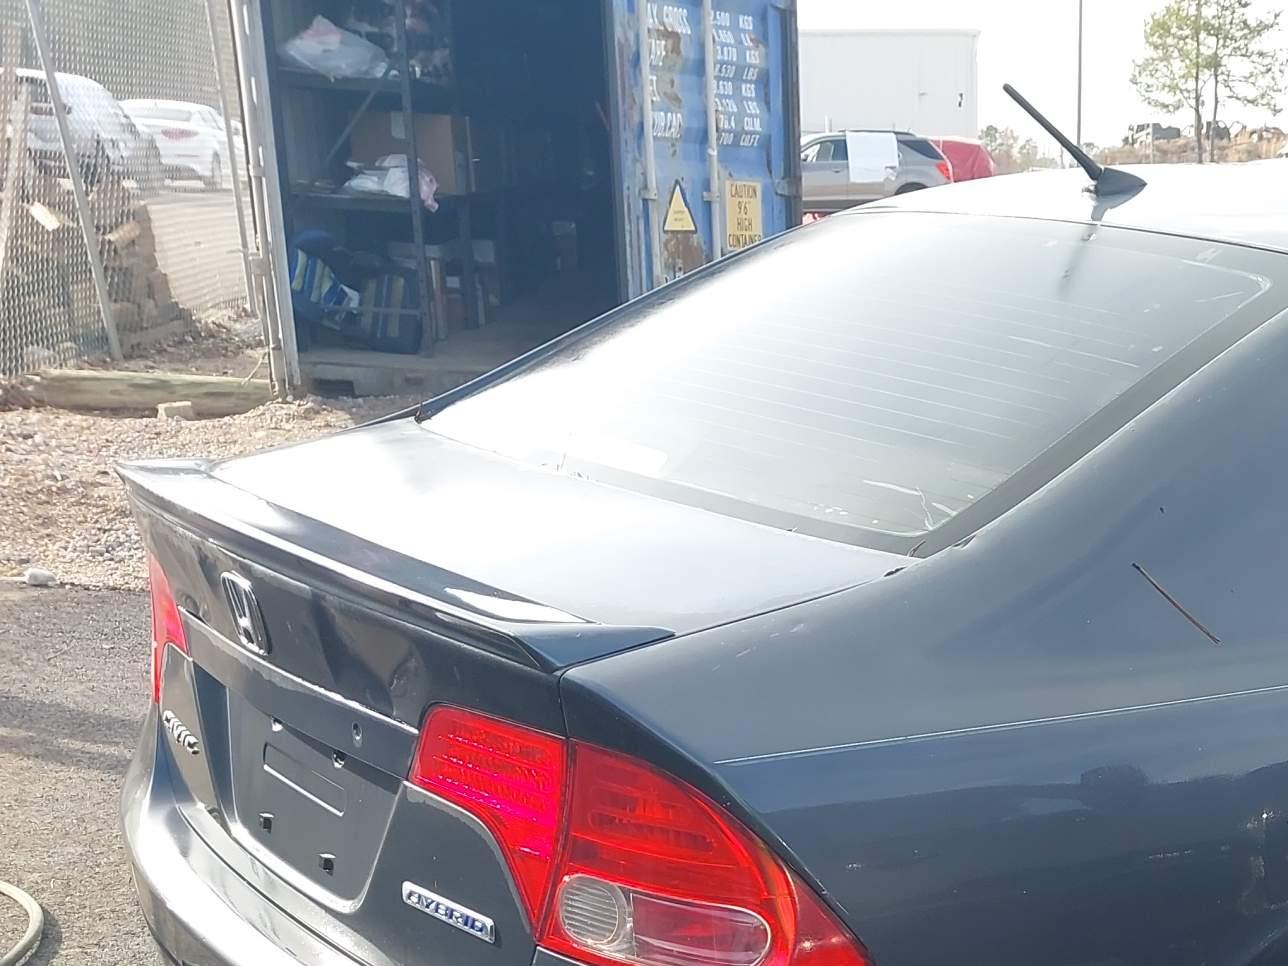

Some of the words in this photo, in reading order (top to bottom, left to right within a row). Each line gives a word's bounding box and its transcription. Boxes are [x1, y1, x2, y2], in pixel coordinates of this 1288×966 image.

[730, 183, 757, 199] CAUTION
[736, 217, 753, 232] HIGH
[162, 709, 201, 755] CIVIC
[406, 889, 486, 934] HYBRID
